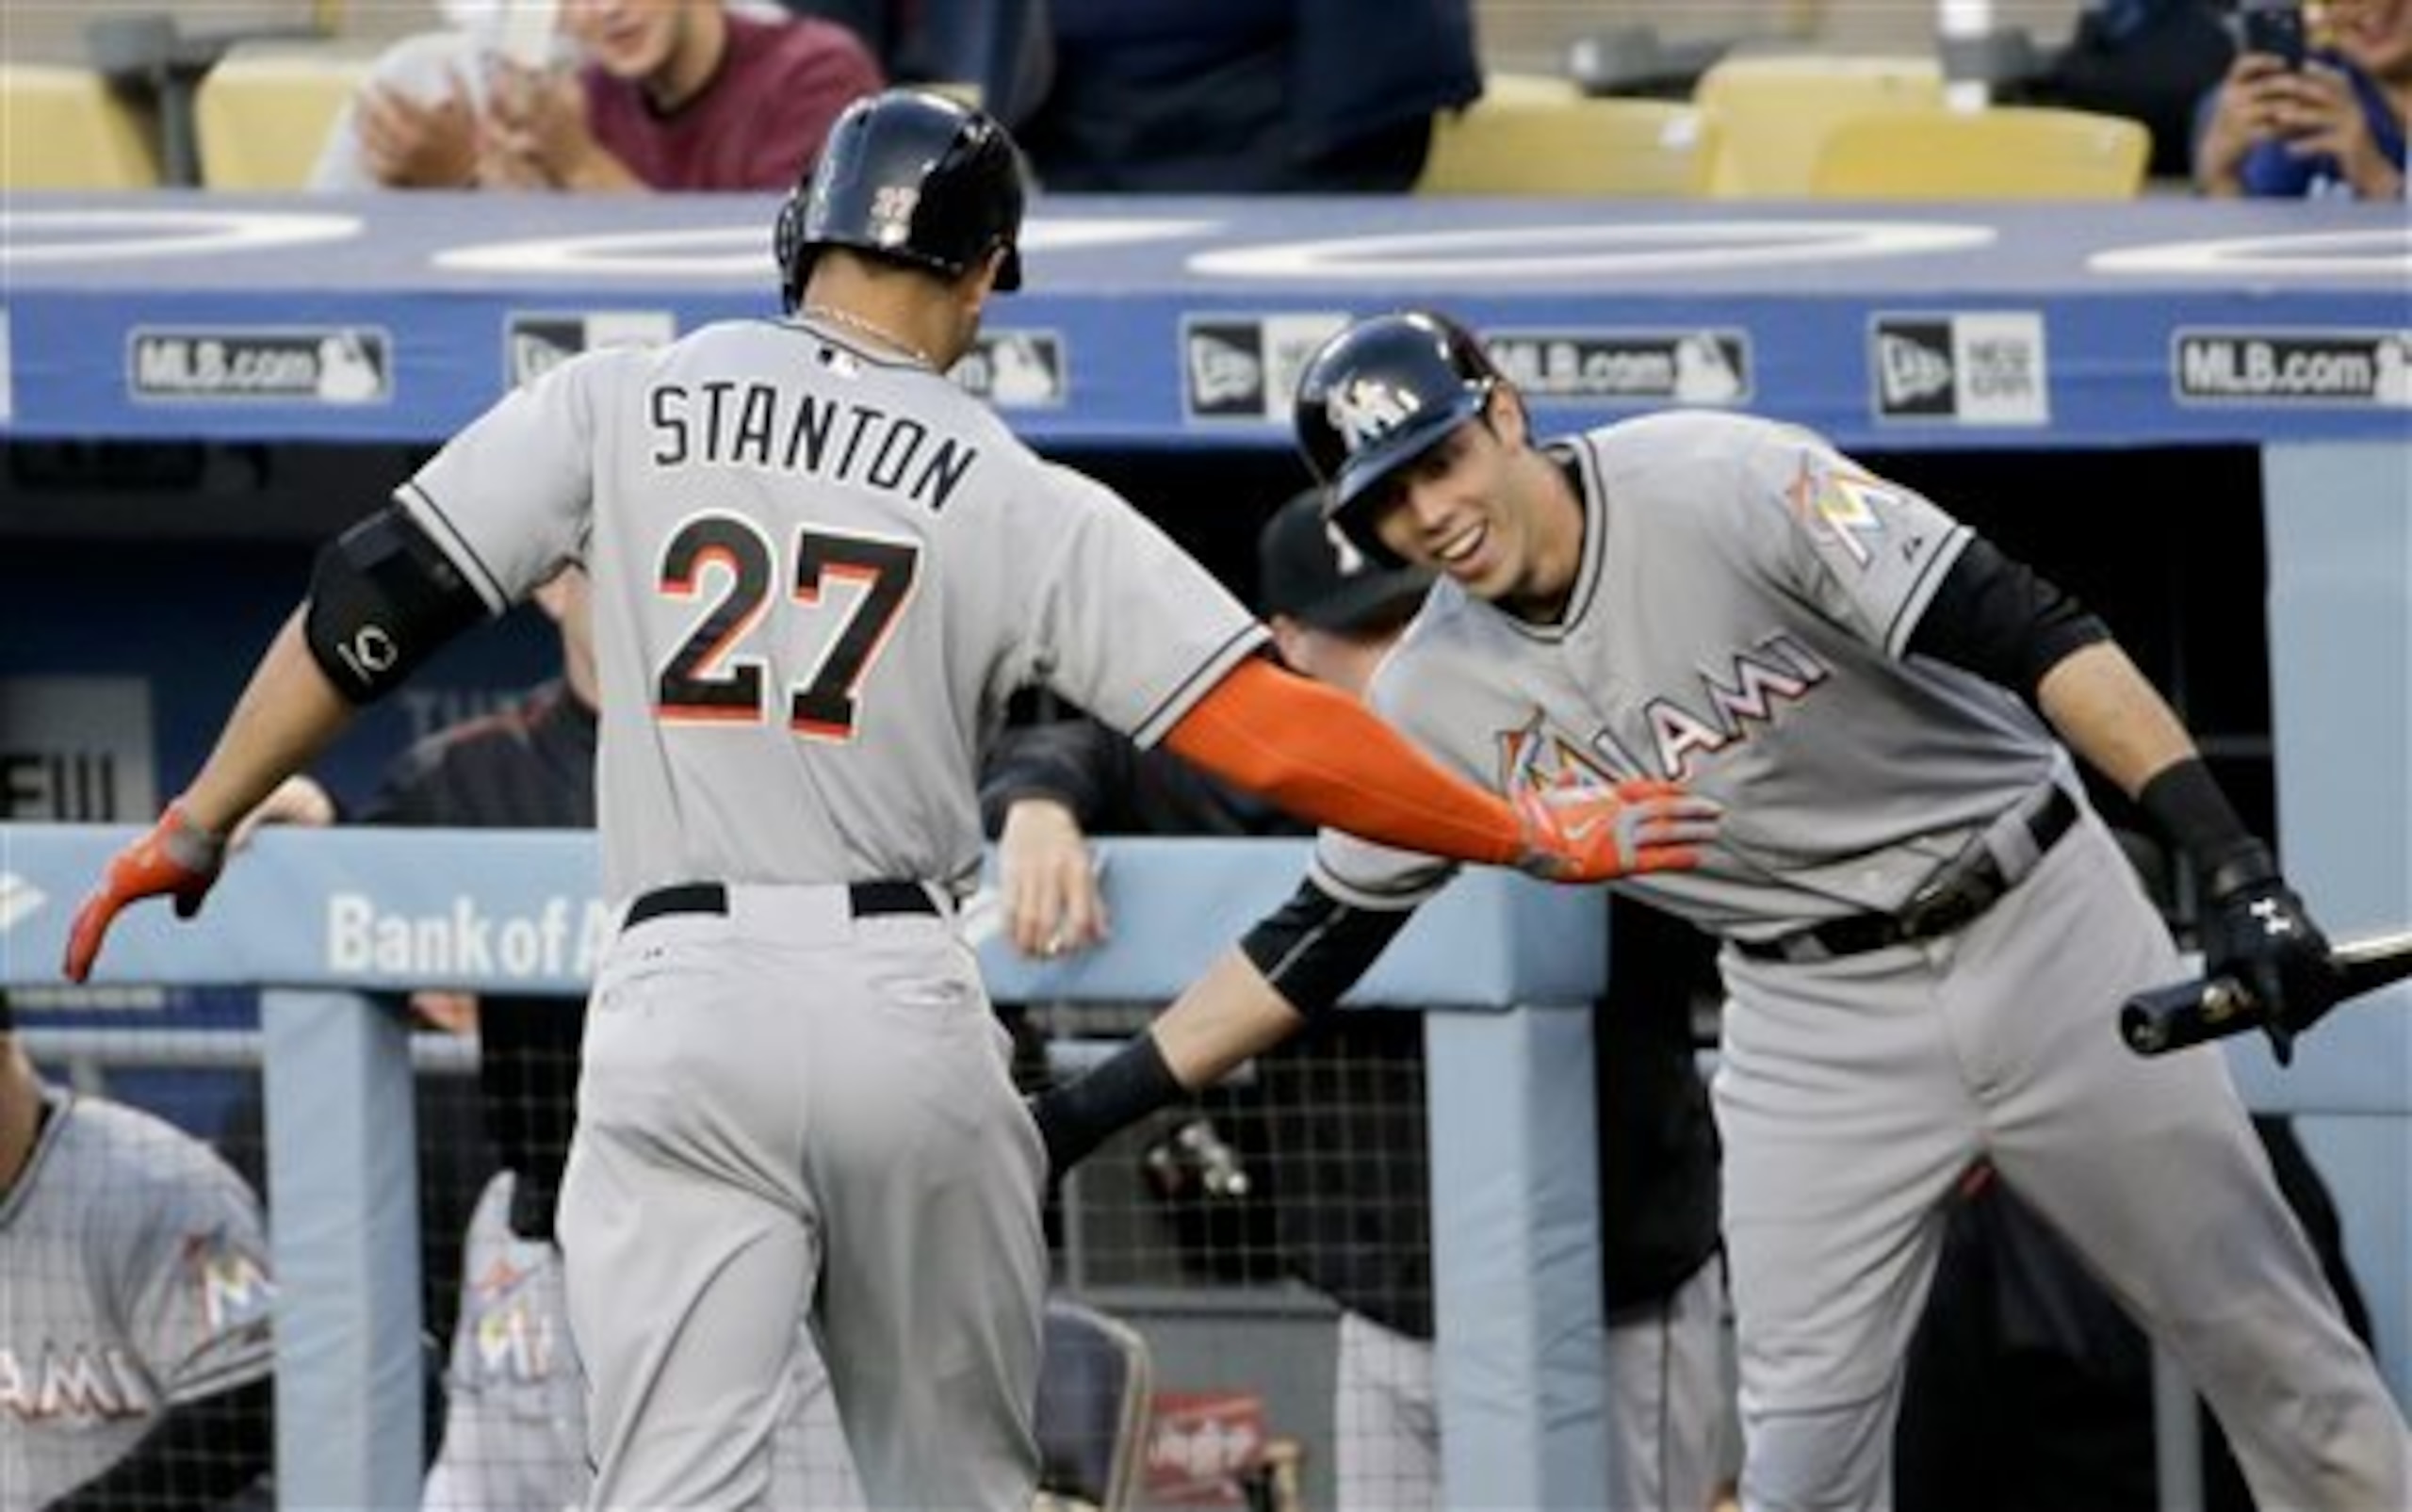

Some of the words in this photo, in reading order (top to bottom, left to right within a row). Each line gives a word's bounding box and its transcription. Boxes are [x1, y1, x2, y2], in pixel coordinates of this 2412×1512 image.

[139, 340, 317, 389] MLB.com
[2184, 341, 2371, 392] MLB.com
[650, 380, 977, 512] STANTON
[652, 508, 922, 740] 27
[329, 895, 493, 972] Bank
[498, 896, 567, 977] of
